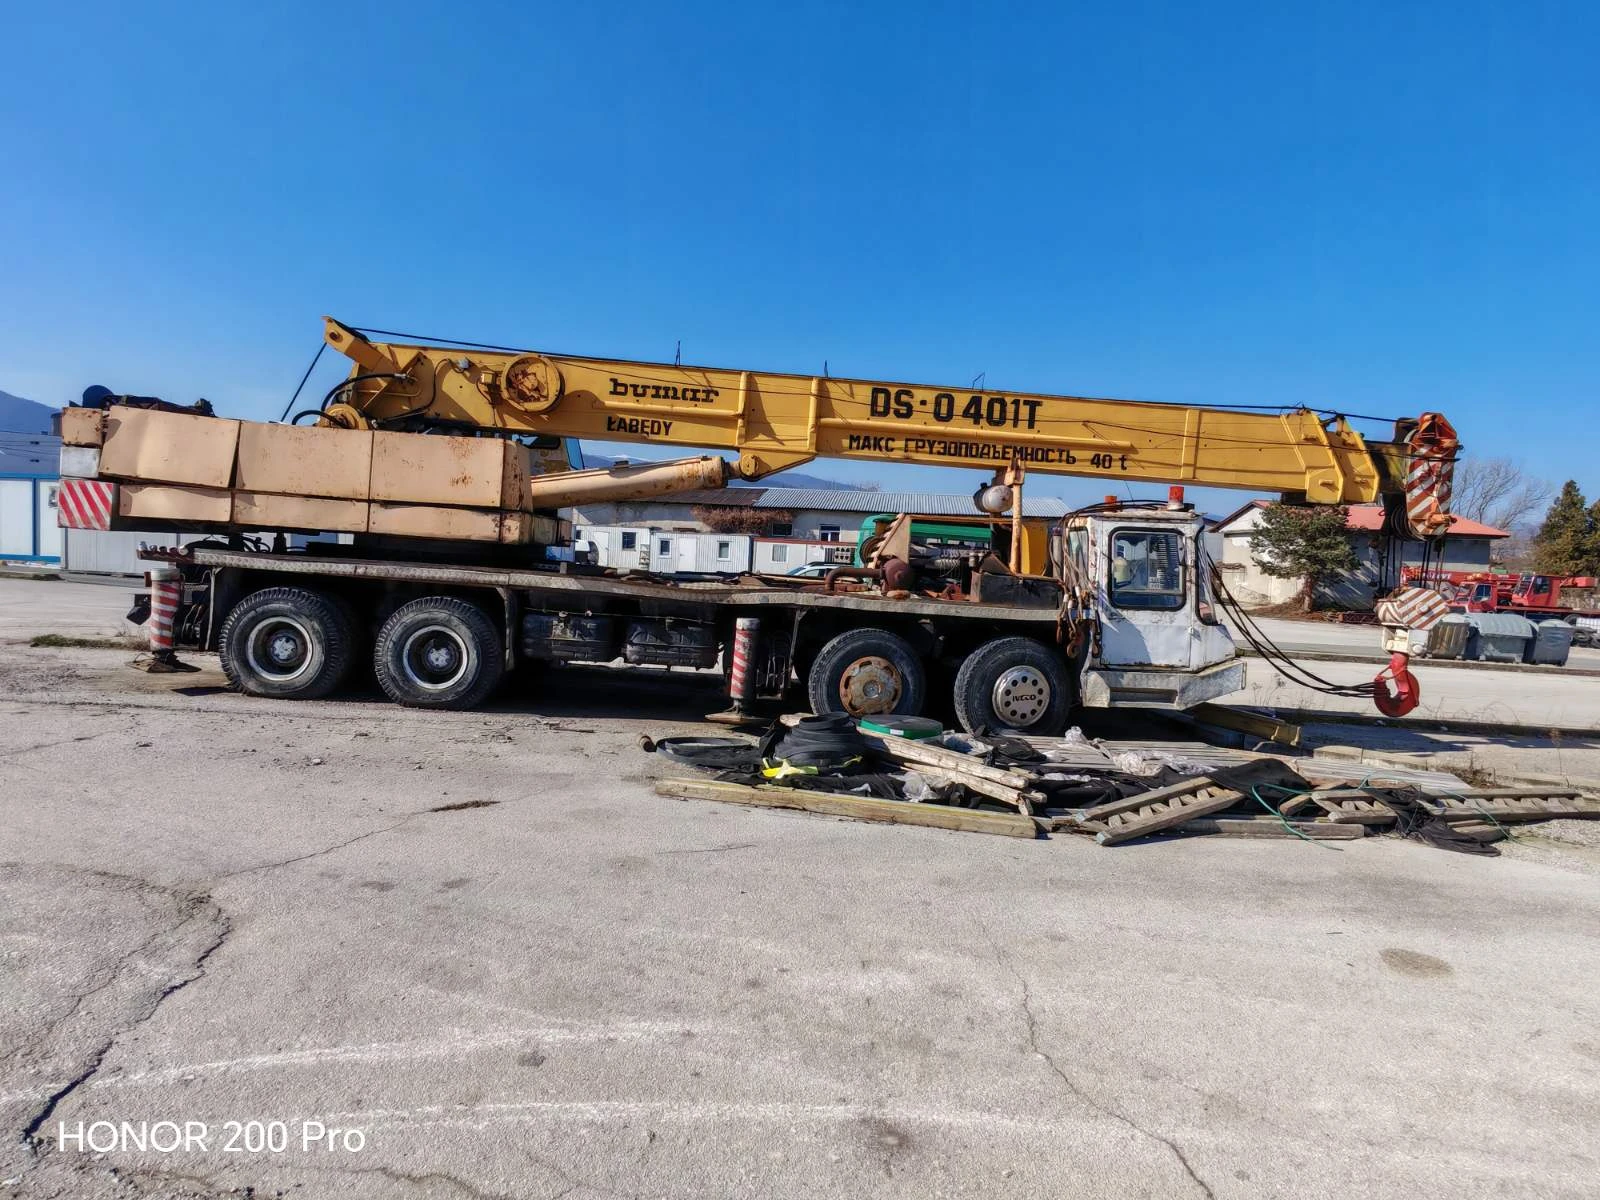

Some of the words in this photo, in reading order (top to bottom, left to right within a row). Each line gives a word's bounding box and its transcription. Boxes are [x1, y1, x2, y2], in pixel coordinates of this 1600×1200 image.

[609, 378, 719, 402] bumar
[607, 416, 673, 437] ŁABĘDY
[848, 434, 896, 452] МАКС
[1090, 453, 1113, 469] 40
[1119, 454, 1128, 470] t
